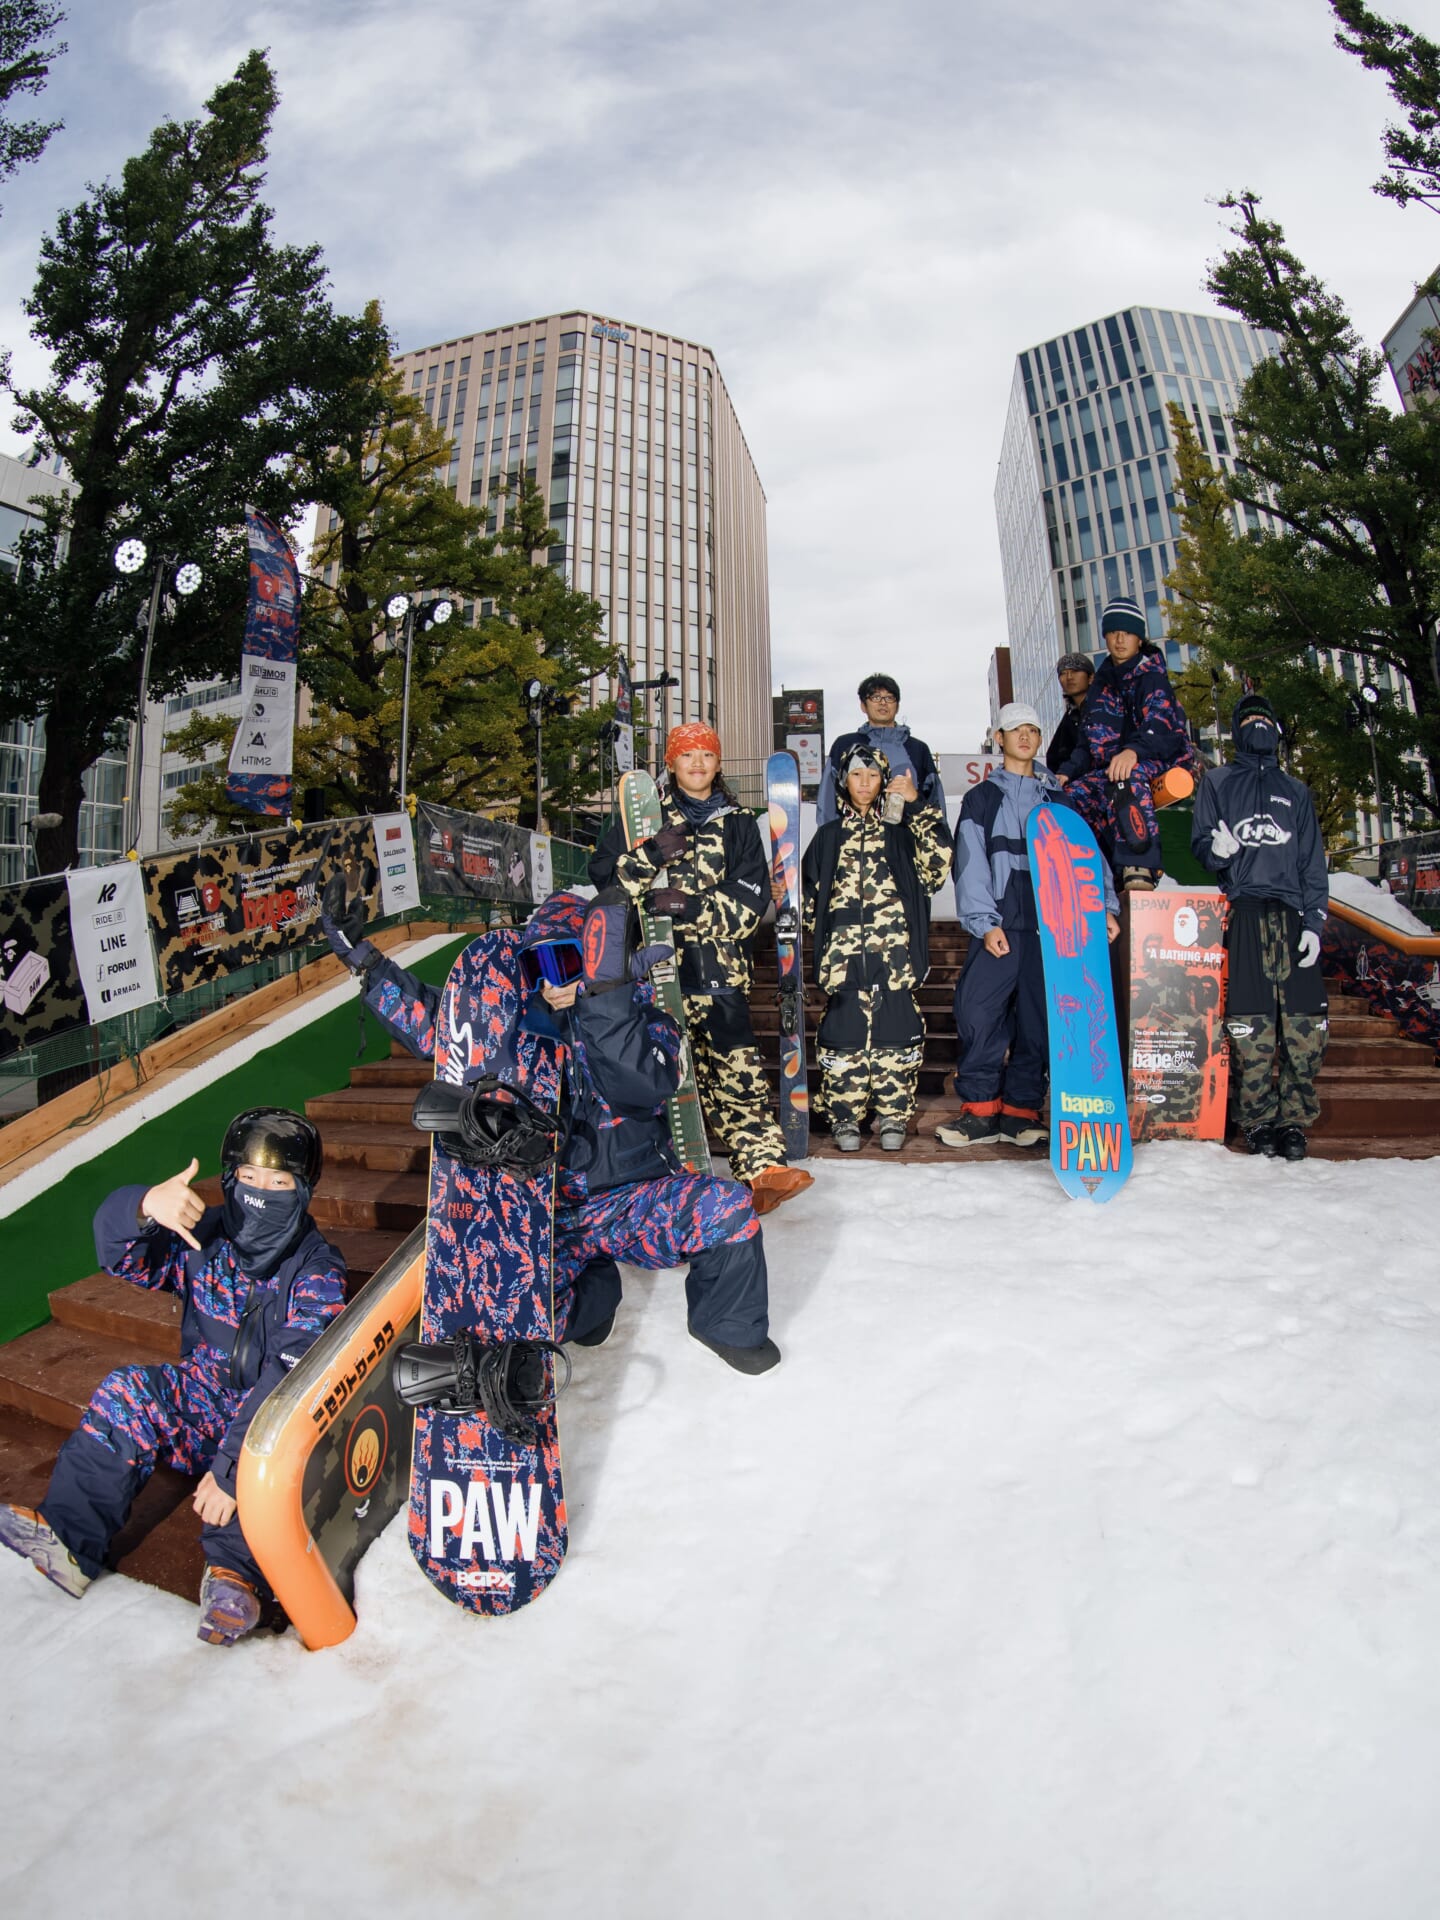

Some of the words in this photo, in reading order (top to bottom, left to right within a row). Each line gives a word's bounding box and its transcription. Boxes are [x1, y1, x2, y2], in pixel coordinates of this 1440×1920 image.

[97, 882, 117, 904] K2
[95, 914, 113, 926] RIDE
[100, 933, 127, 953] LINE
[1160, 949, 1201, 961] BATHING
[107, 958, 137, 975] FORUM
[113, 982, 141, 997] ARMADA
[1059, 1120, 1122, 1172] PAW
[243, 1194, 266, 1209] PAW.
[430, 1478, 543, 1561] PAW
